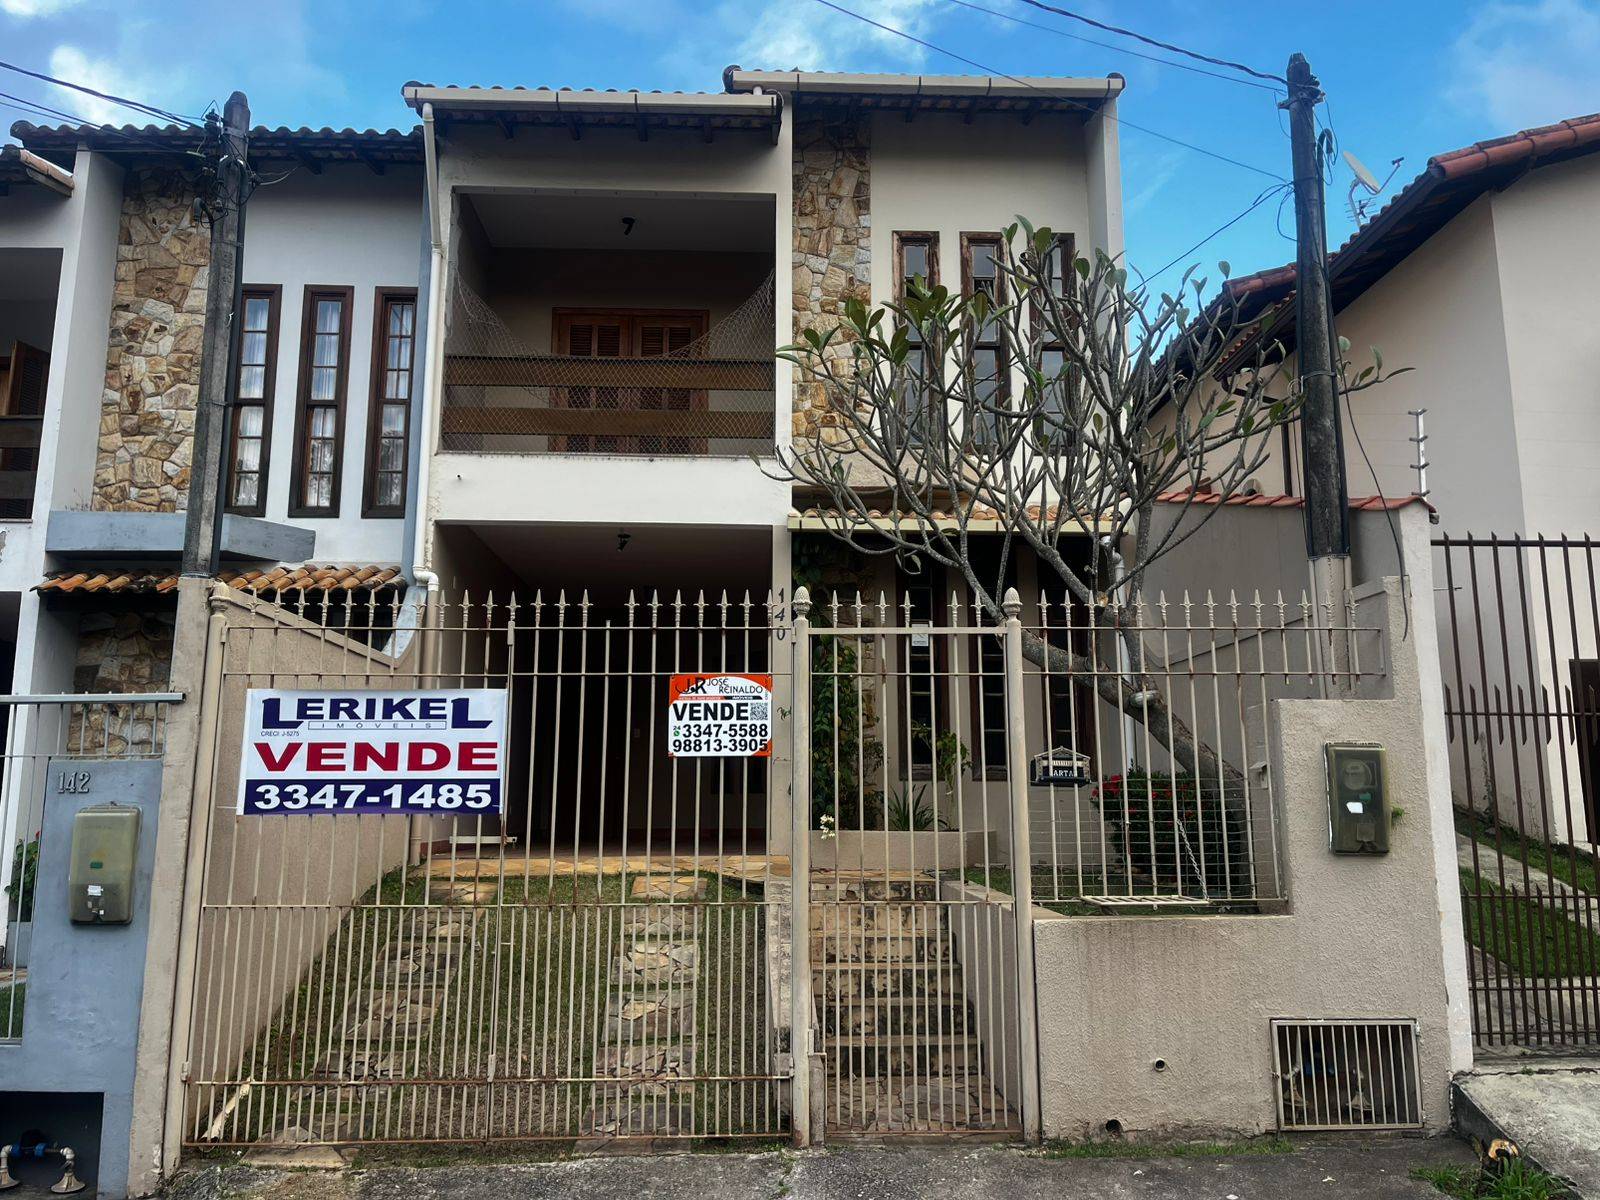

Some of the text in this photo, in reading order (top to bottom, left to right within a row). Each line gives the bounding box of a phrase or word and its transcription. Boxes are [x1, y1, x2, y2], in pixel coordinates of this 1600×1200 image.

[718, 685, 763, 694] REINALDO
[262, 698, 493, 729] LERIKEL
[672, 703, 749, 721] VENDE
[682, 723, 768, 738] 3347-5588
[672, 739, 768, 752] 98813-3905
[253, 742, 498, 772] VENDE
[57, 772, 92, 794] 142
[254, 784, 492, 809] 3347-1485
